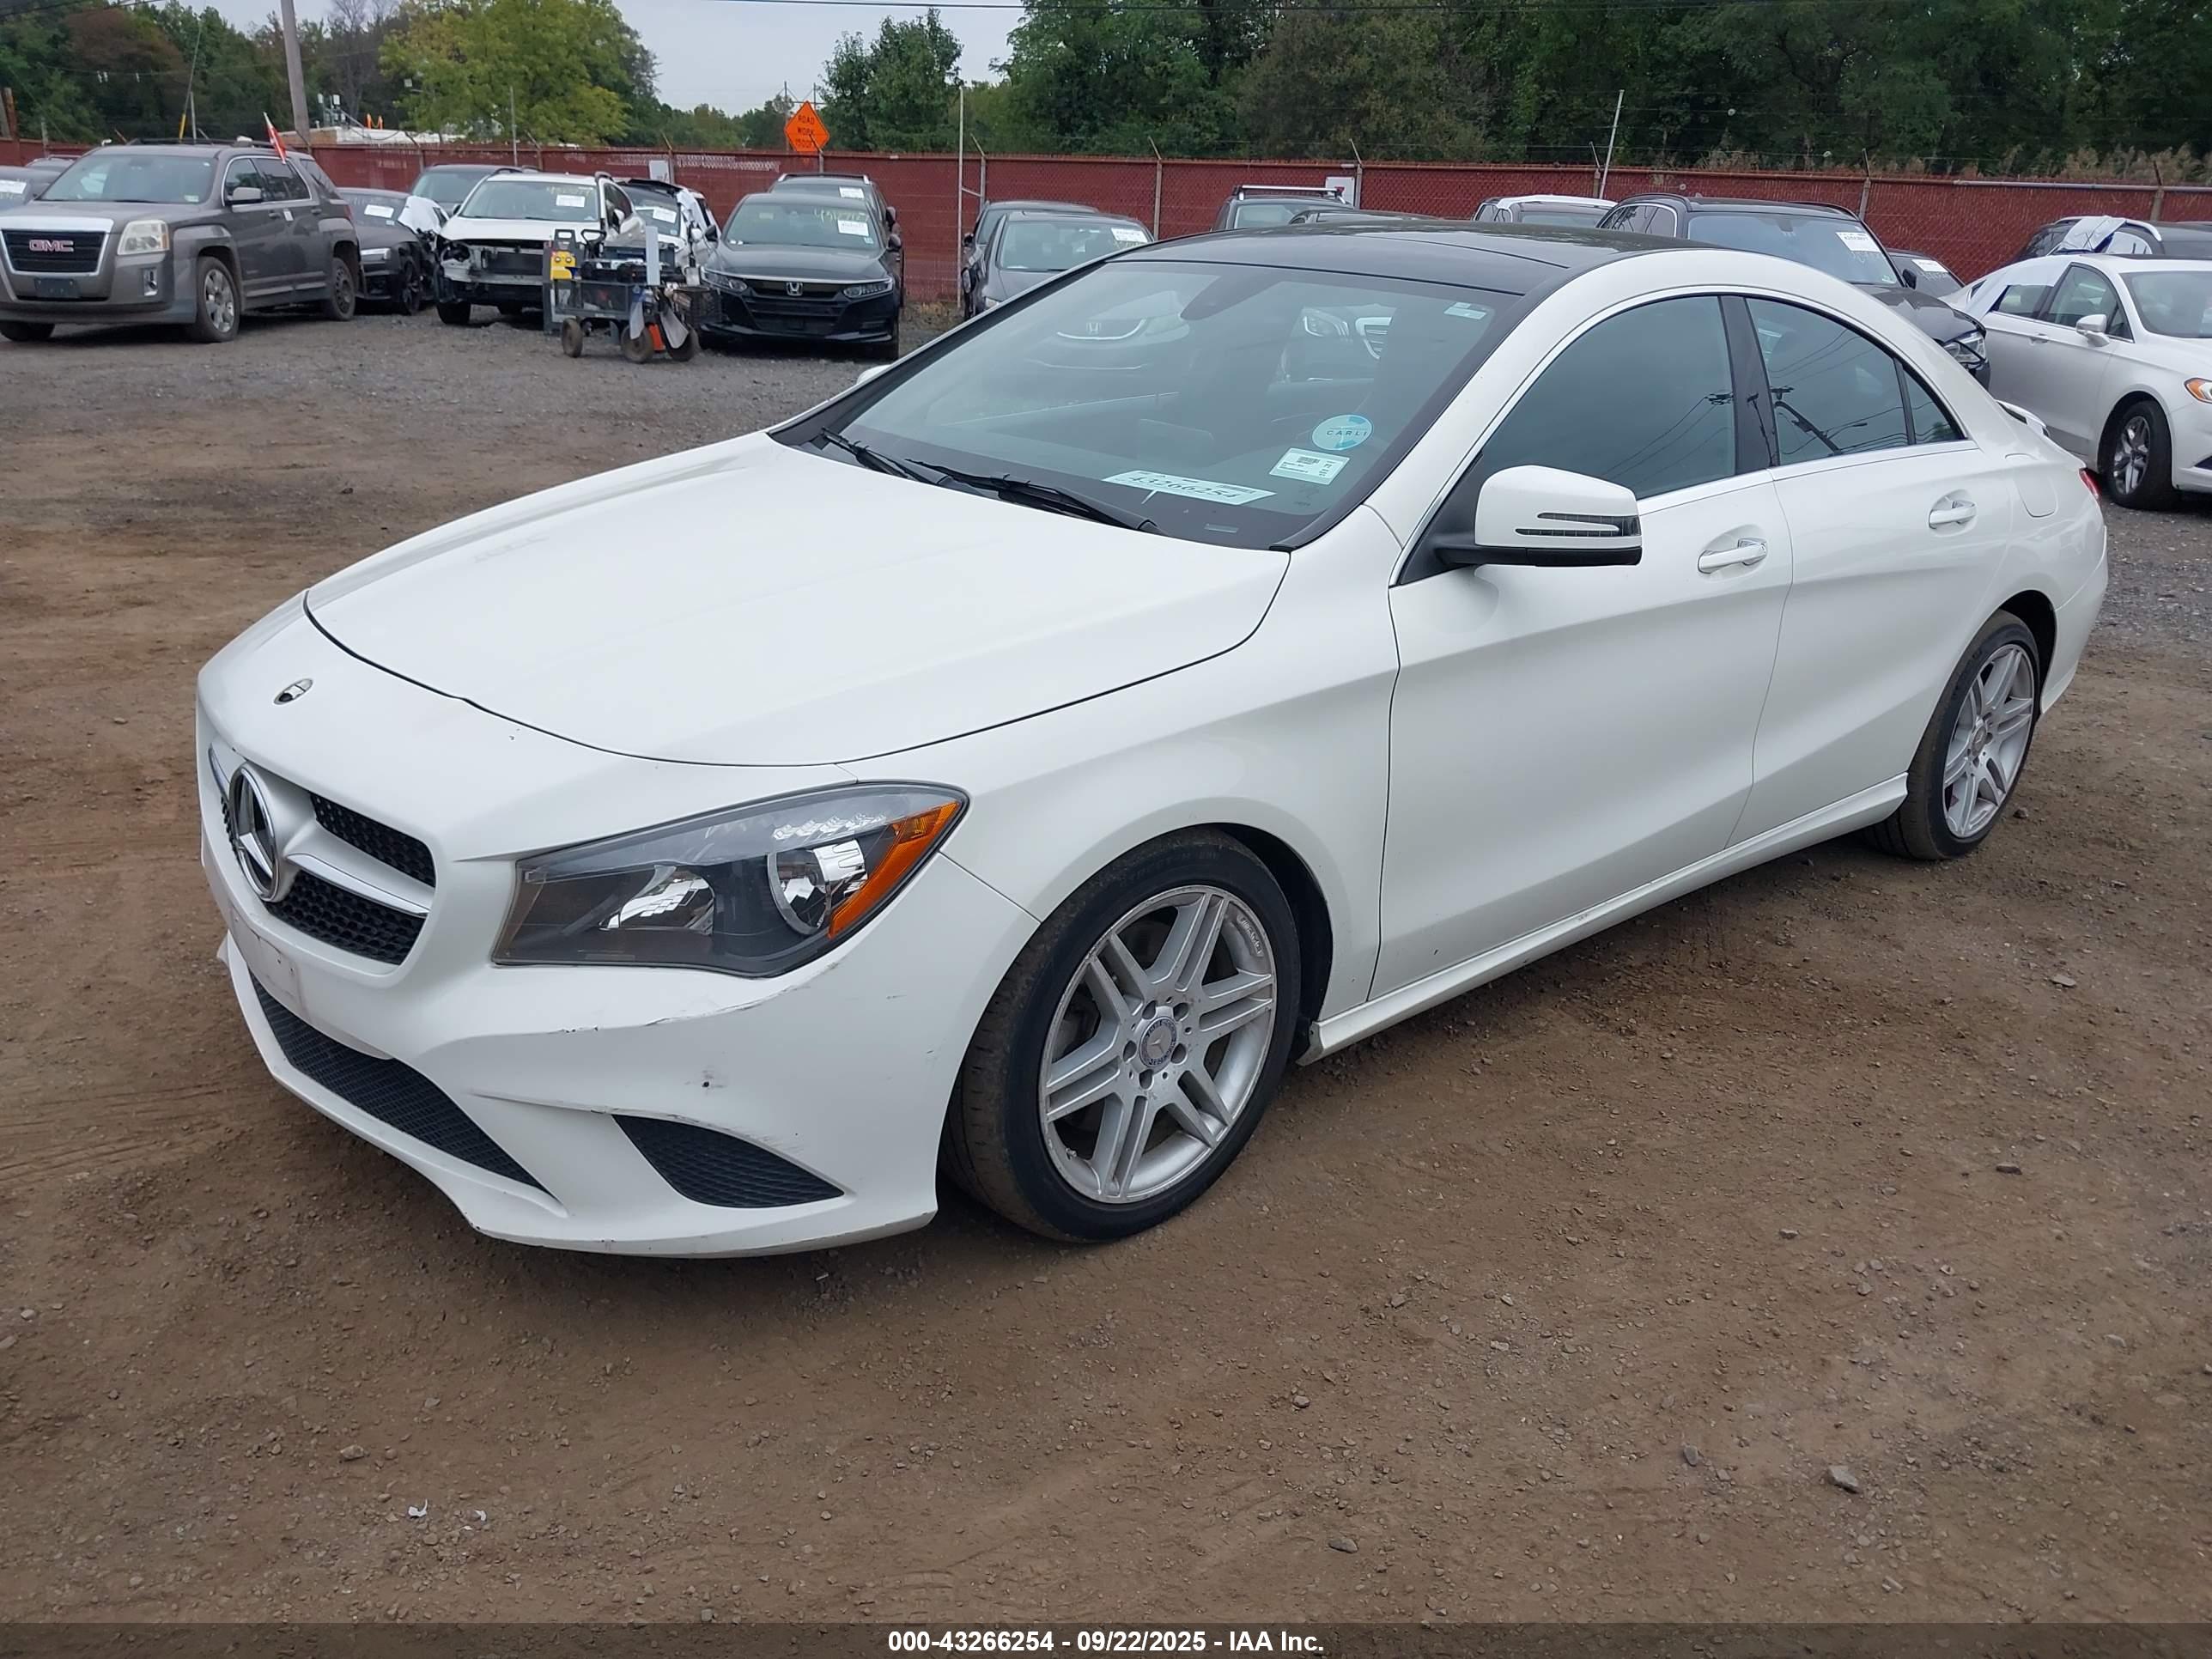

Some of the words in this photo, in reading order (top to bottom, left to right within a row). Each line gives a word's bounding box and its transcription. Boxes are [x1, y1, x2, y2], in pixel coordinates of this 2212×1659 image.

[797, 114, 815, 125] ROAD
[797, 127, 815, 136] WORK
[29, 240, 75, 252] GMC
[1129, 476, 1241, 498] 43266254
